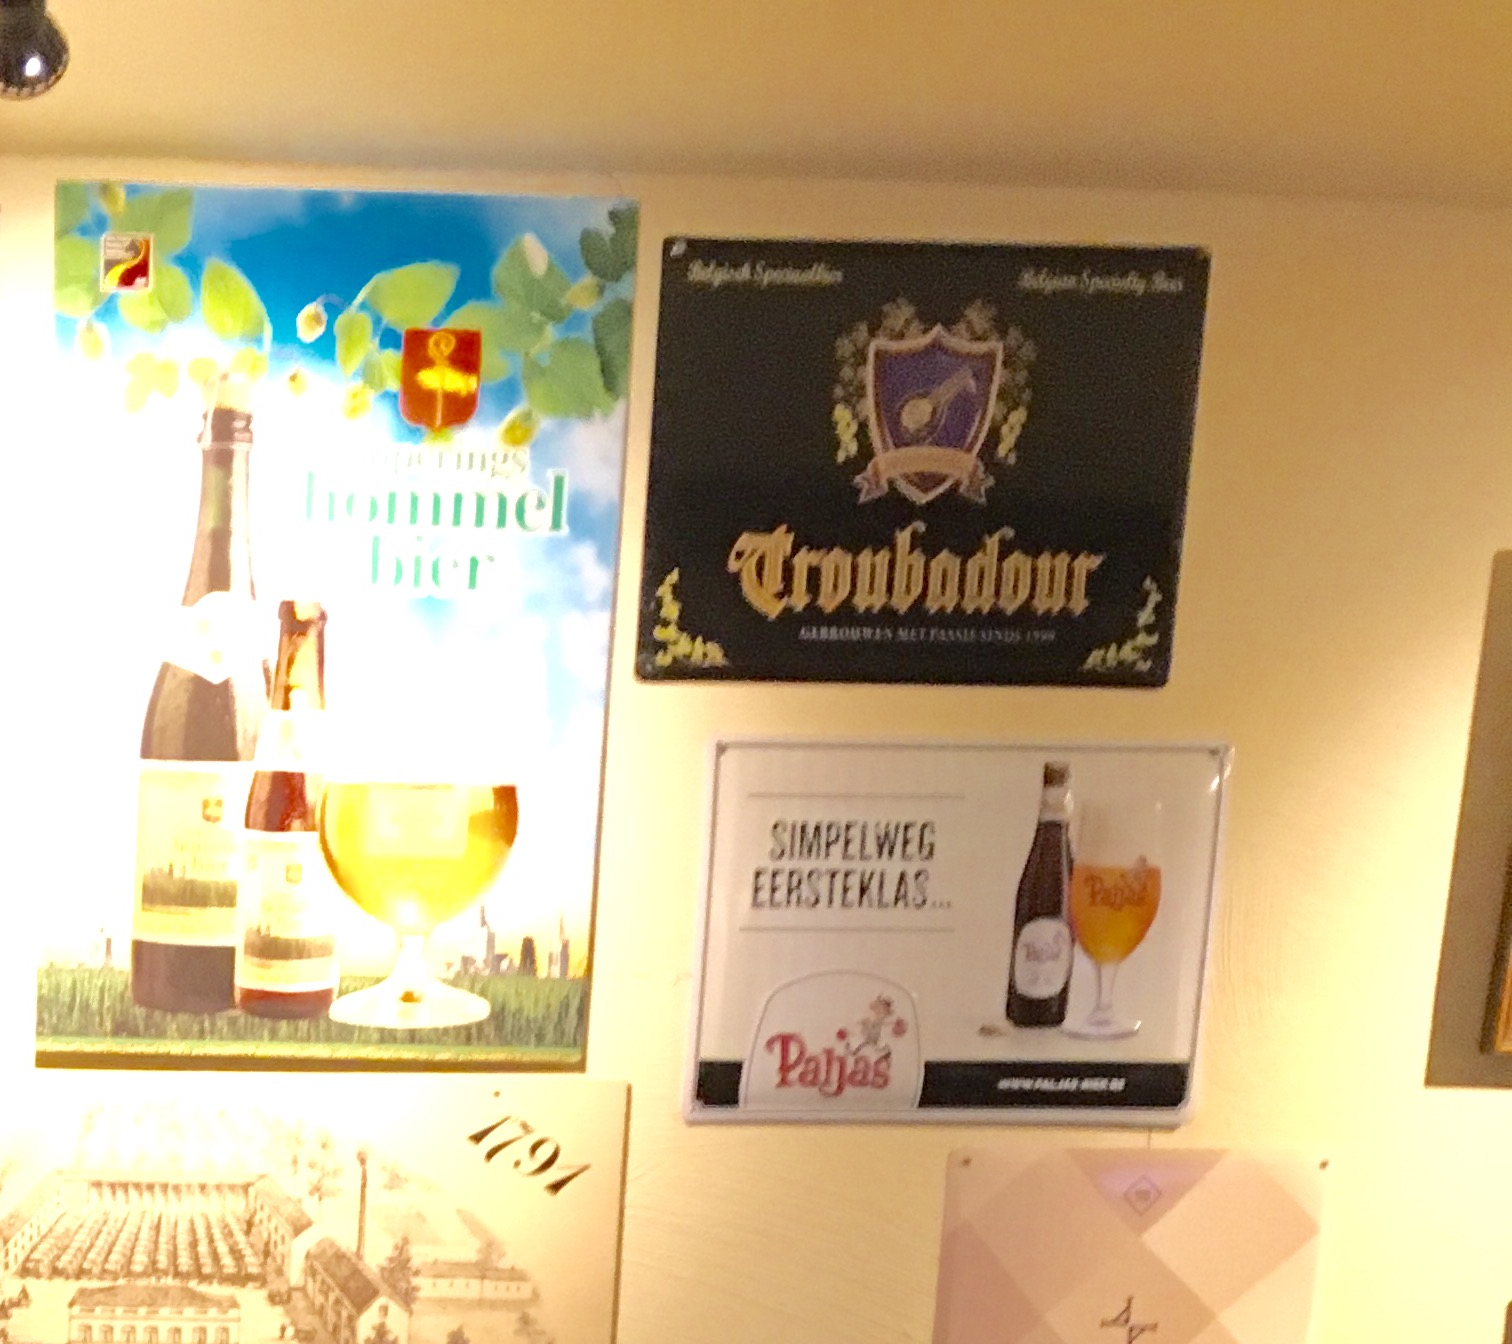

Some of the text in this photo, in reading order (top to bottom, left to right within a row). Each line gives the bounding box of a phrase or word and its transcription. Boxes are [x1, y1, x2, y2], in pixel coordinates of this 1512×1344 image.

[305, 470, 569, 533] hommel
[371, 535, 495, 590] bier
[727, 521, 1105, 621] Troubadour
[768, 819, 936, 862] SIMPELWEG
[765, 1032, 892, 1098] Paljas
[467, 1115, 592, 1197] 1791
